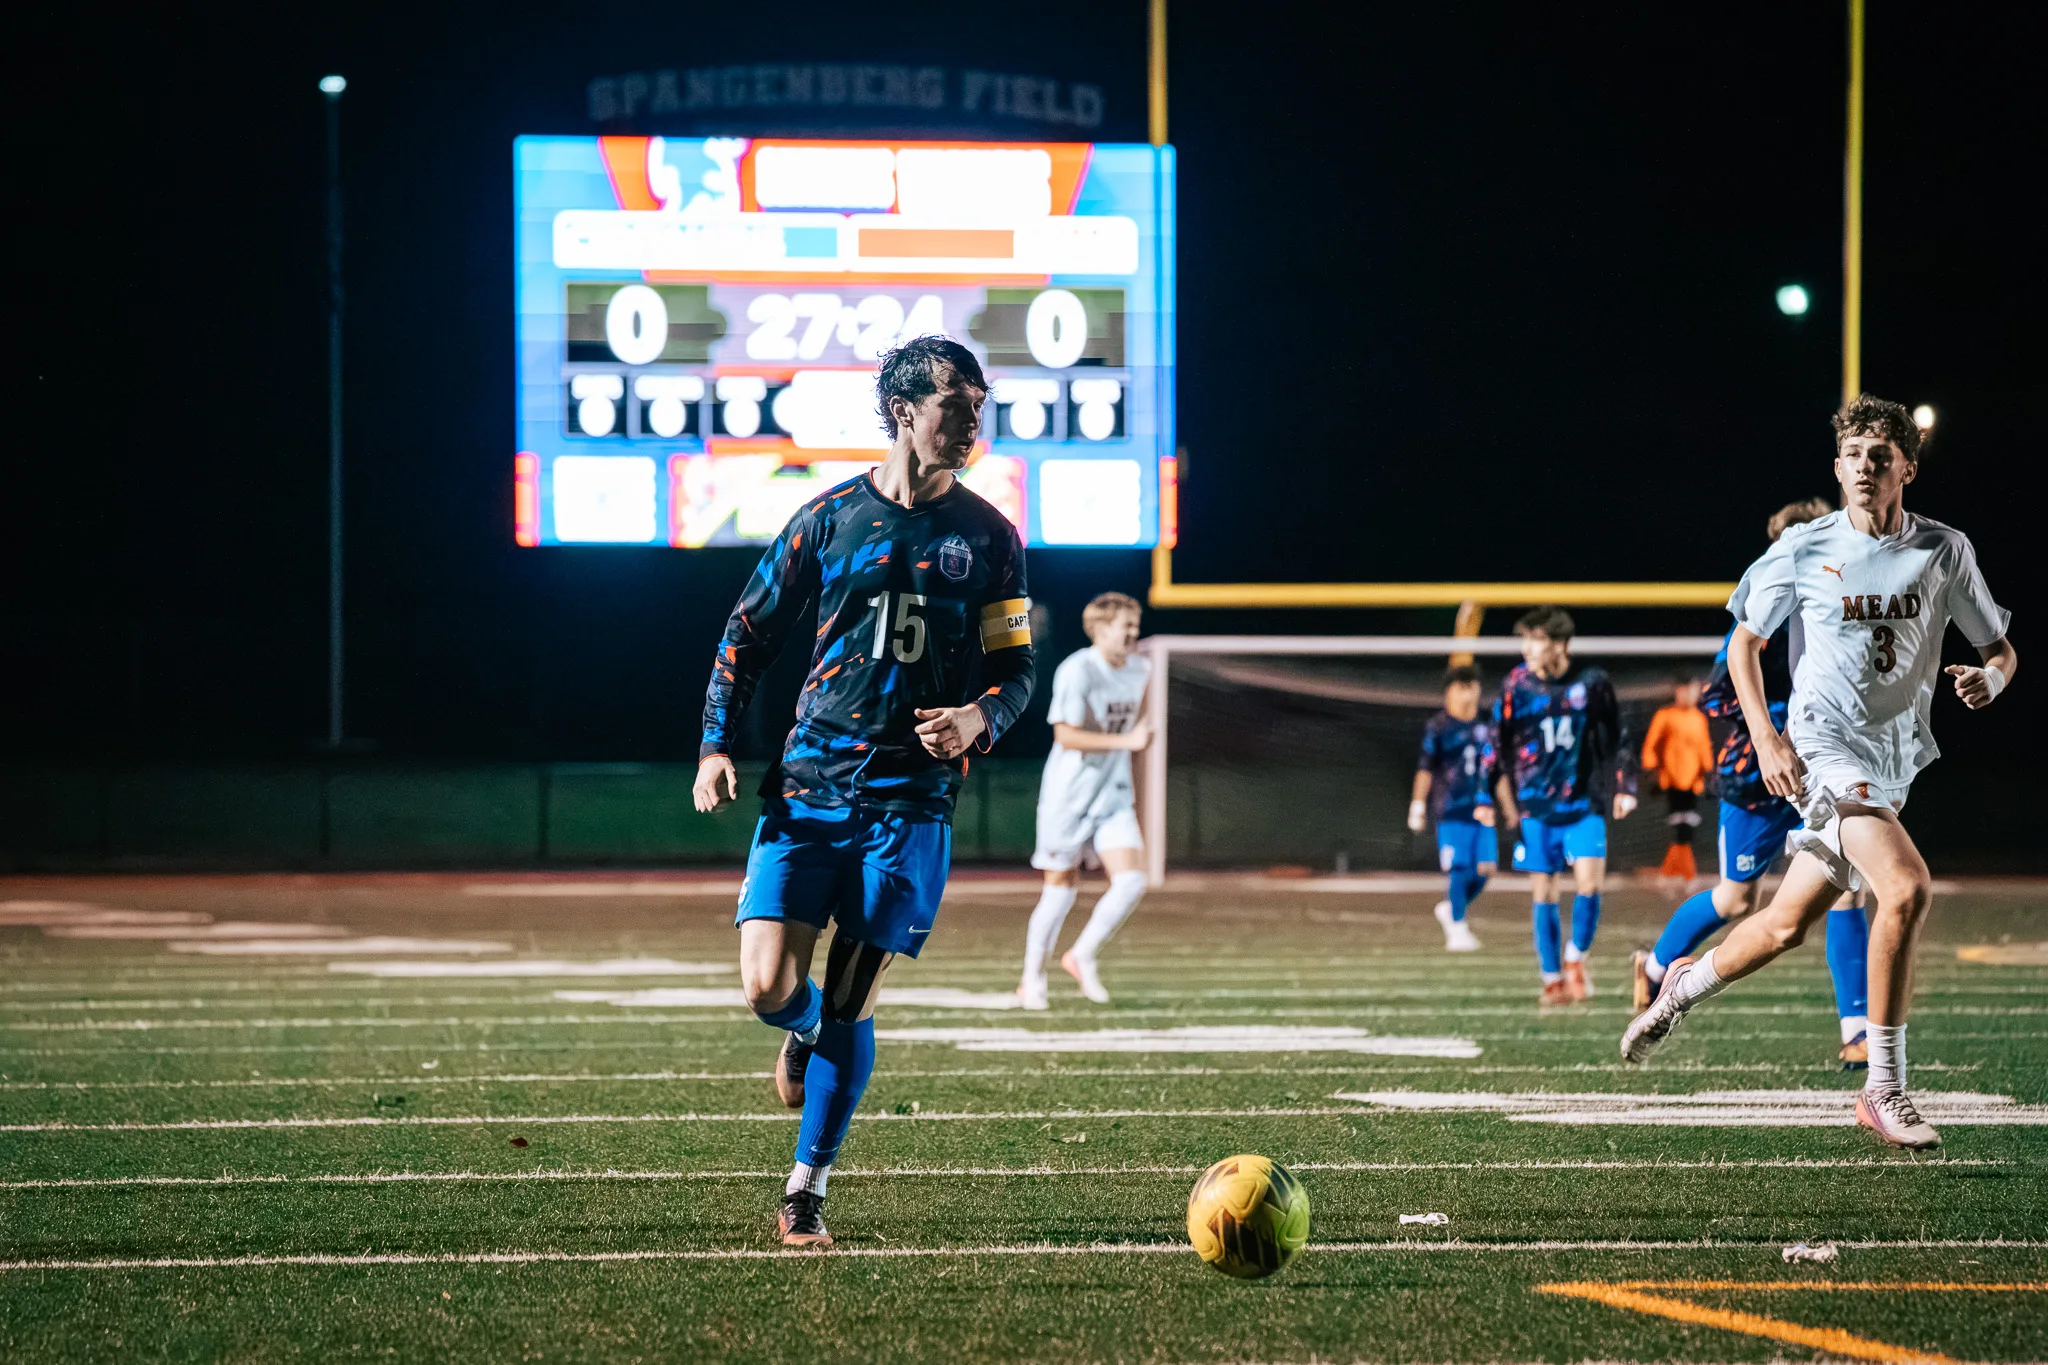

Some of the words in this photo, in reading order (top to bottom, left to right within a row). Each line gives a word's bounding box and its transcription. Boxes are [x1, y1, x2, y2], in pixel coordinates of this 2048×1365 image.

[588, 64, 945, 120] SPANGENBERG
[961, 70, 1105, 127] FIELD
[606, 284, 668, 365] 0
[745, 293, 944, 361] 27:24
[1026, 289, 1088, 369] 0
[868, 591, 927, 664] 15
[1842, 594, 1921, 622] MEAD
[1873, 625, 1897, 673] 3
[1540, 715, 1576, 753] 14
